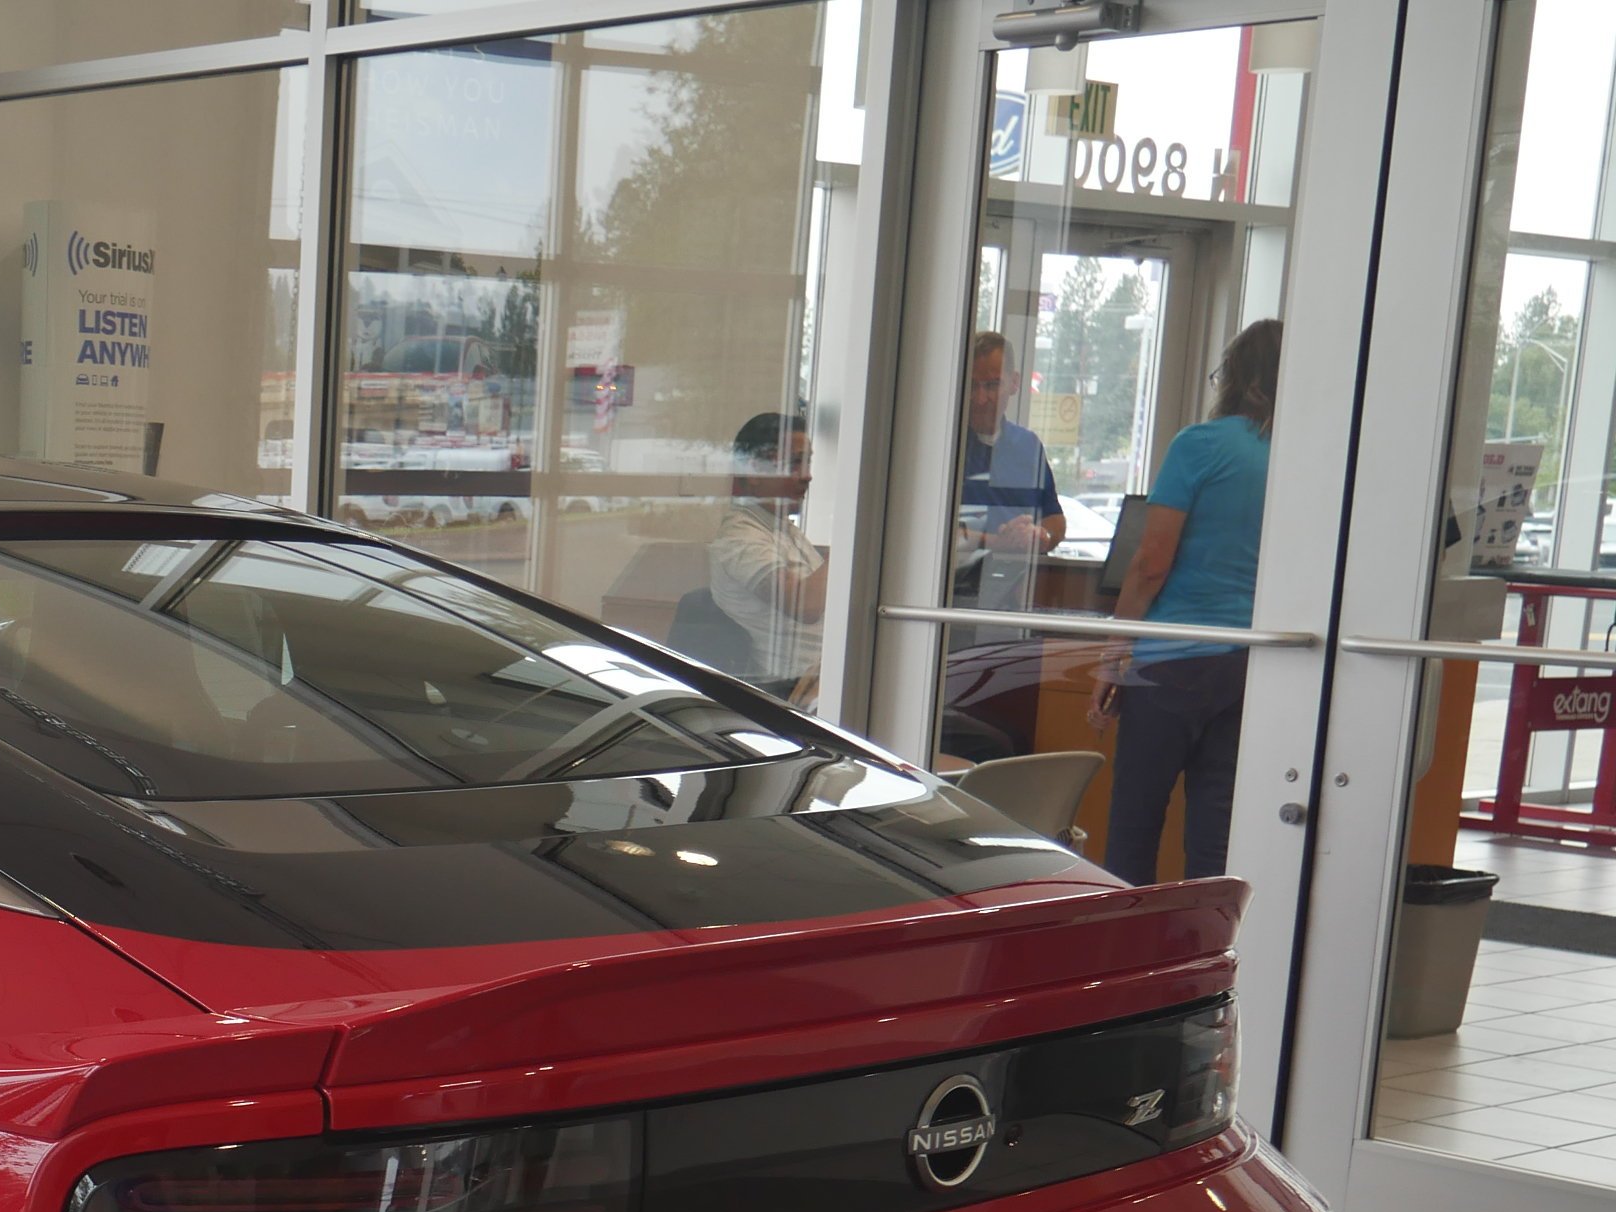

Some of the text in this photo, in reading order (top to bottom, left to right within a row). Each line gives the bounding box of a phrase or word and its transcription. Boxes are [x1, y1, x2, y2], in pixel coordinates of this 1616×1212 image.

[444, 73, 505, 104] YOU
[1069, 82, 1111, 134] EXIT
[78, 289, 107, 304] Your
[110, 292, 128, 306] trial
[78, 309, 148, 338] LISTEN
[912, 1117, 995, 1151] NISSAN
